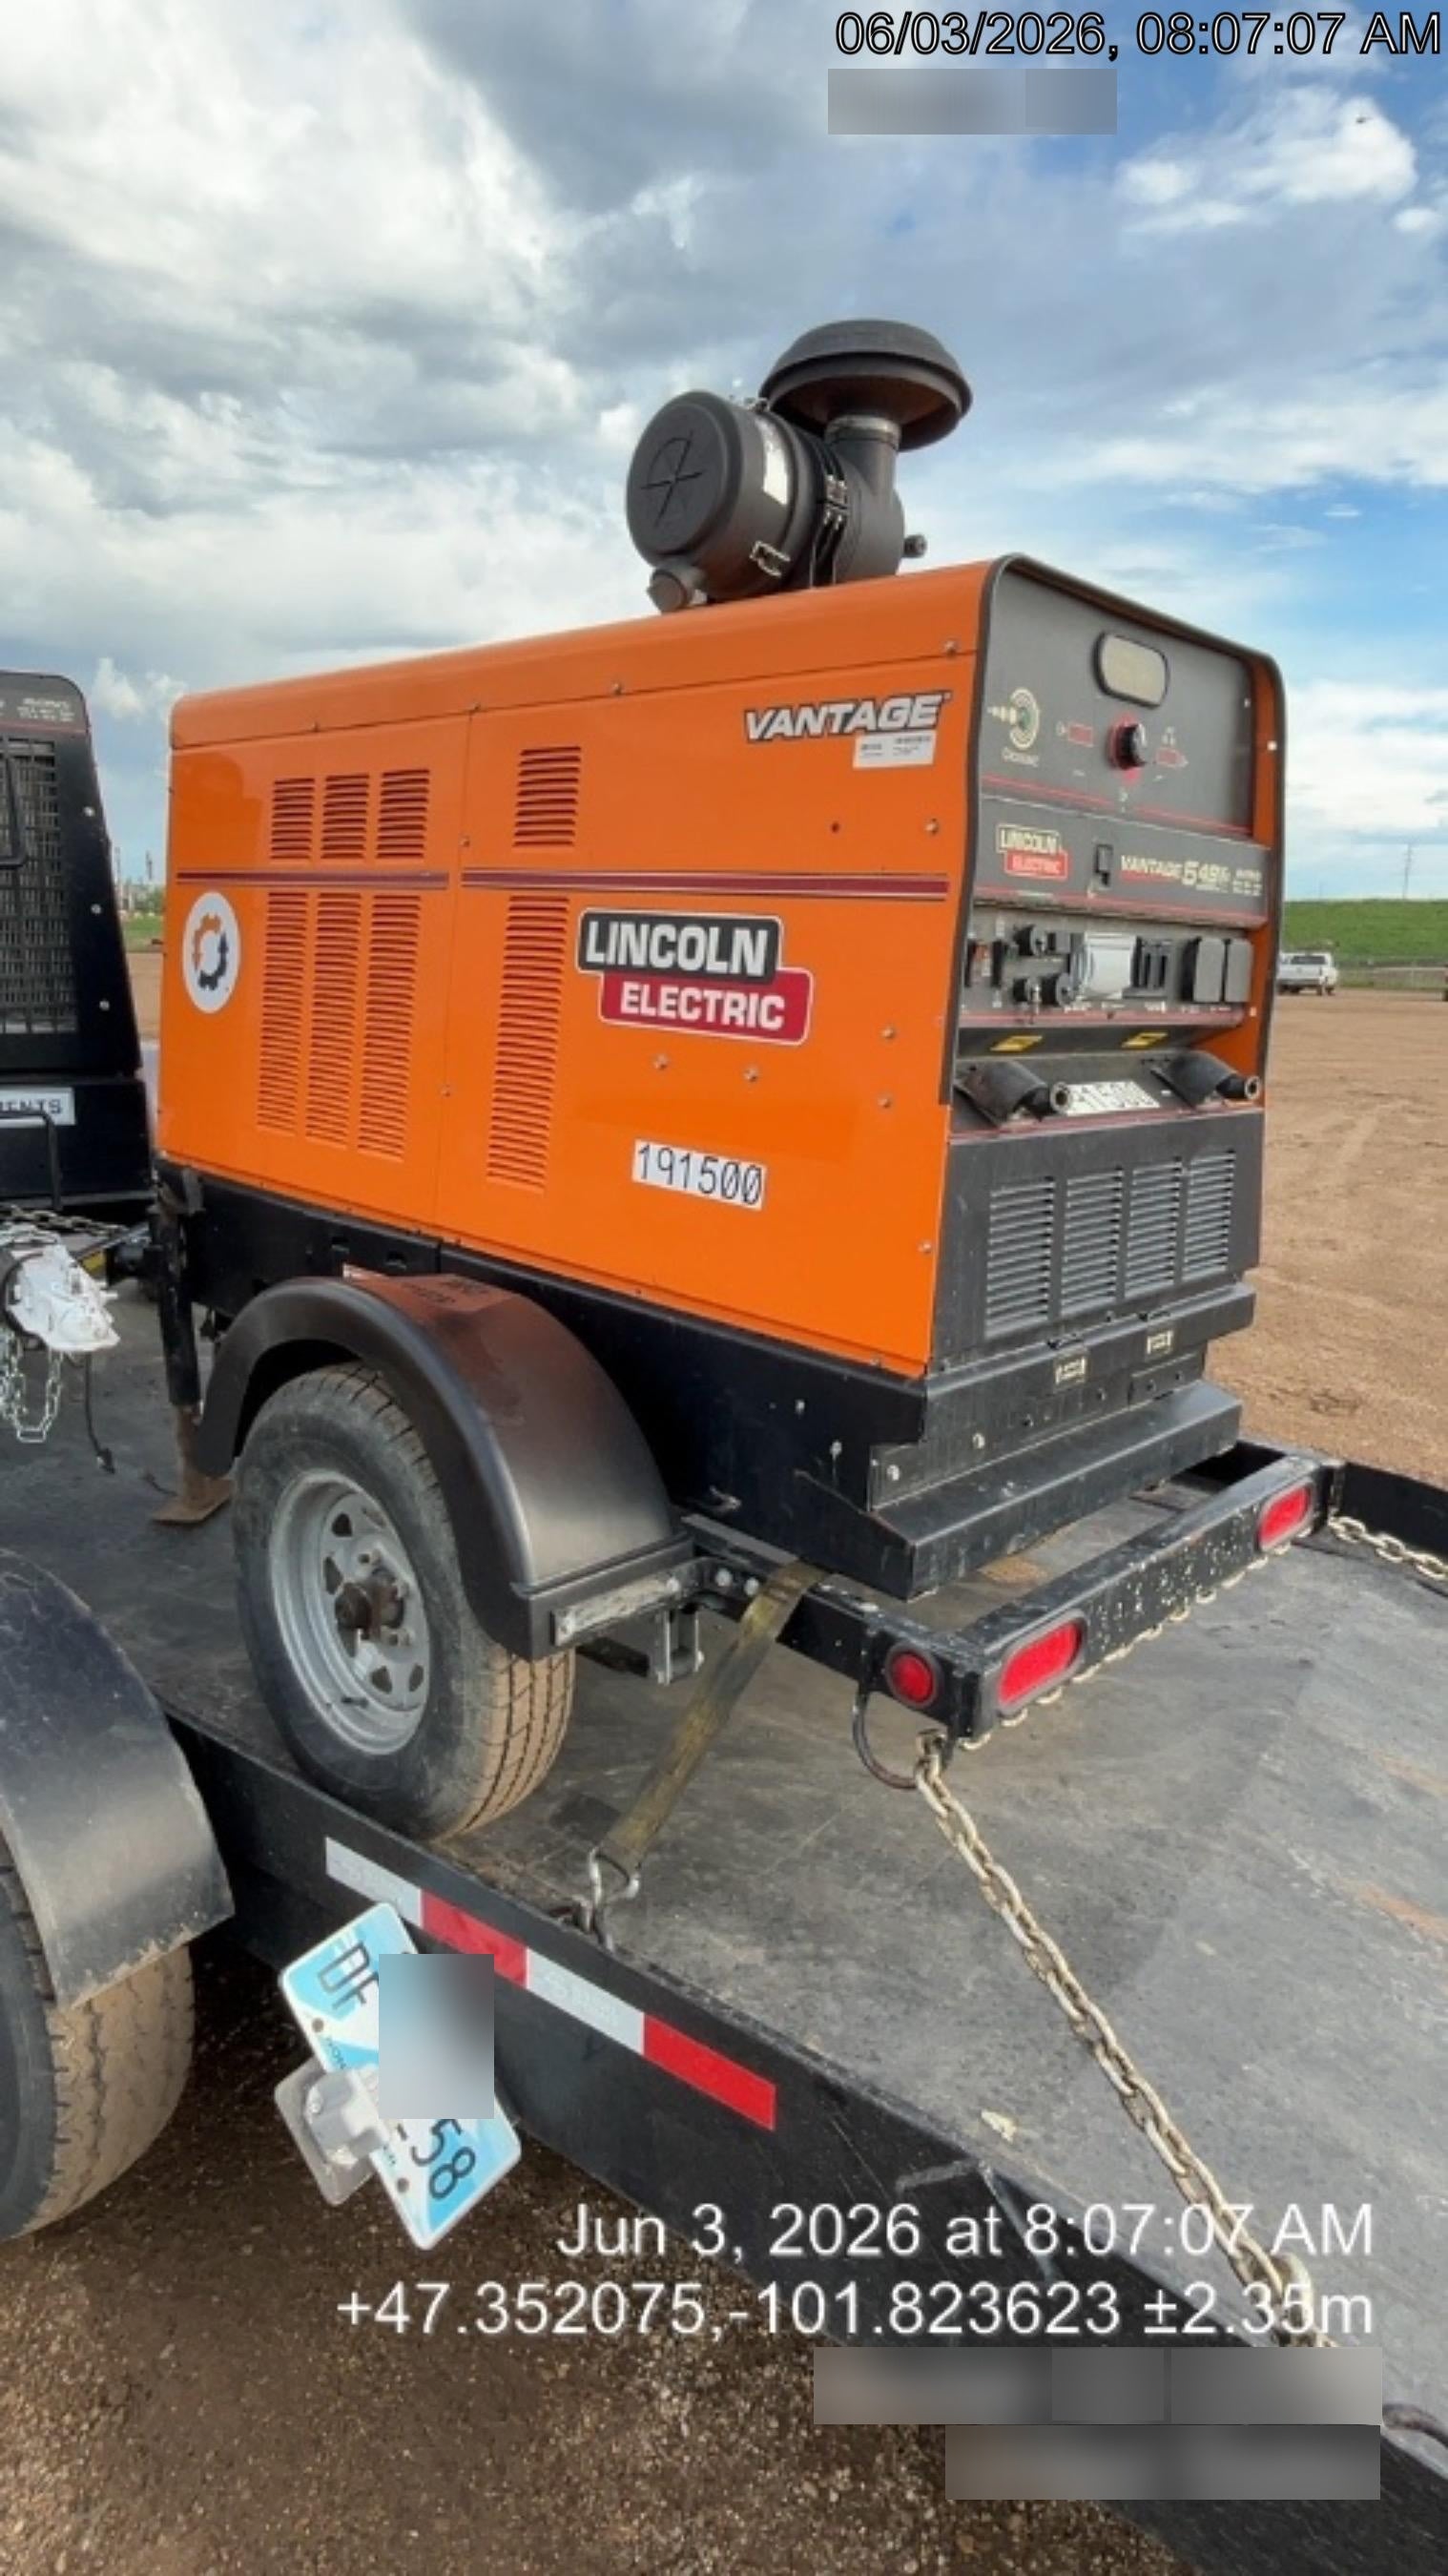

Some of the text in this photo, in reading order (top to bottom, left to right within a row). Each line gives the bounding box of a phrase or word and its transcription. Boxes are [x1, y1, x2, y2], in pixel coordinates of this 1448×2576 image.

[745, 694, 944, 742] VANTAGE
[585, 920, 769, 977] LINCOLN
[620, 980, 786, 1030] ELECTRIC
[637, 1144, 763, 1206] 191500
